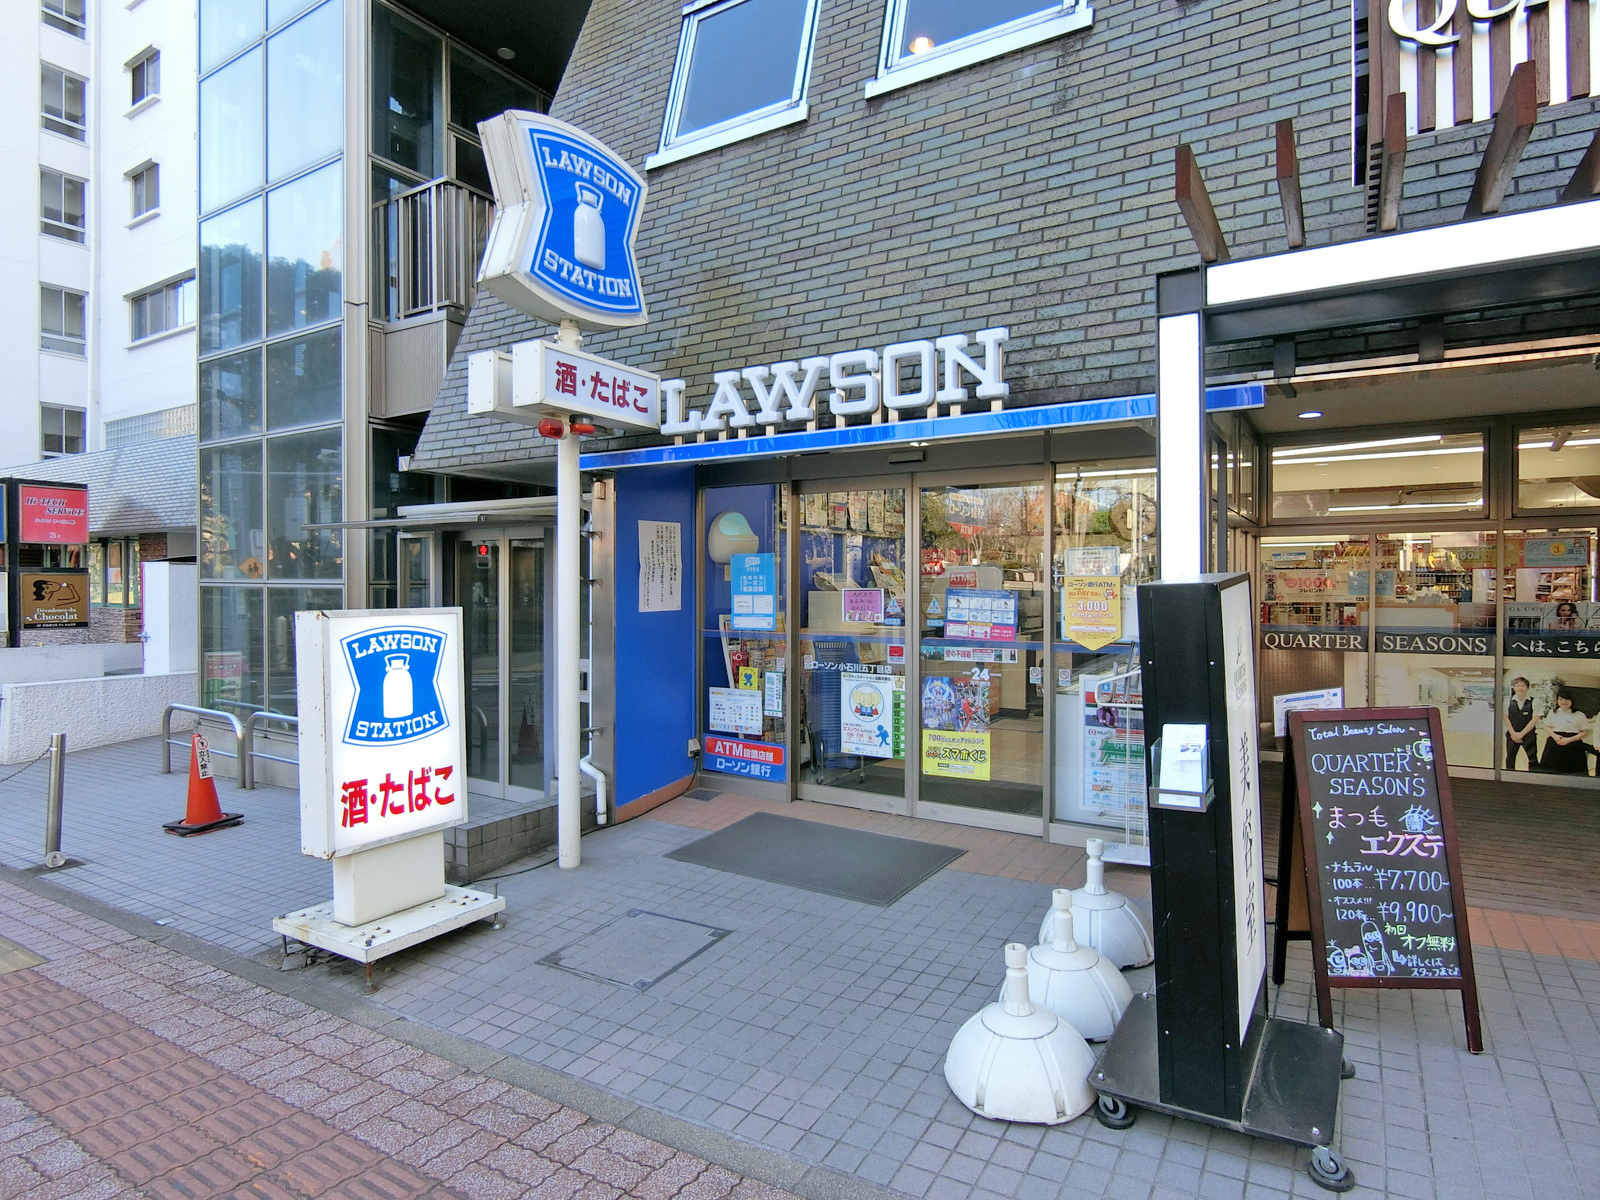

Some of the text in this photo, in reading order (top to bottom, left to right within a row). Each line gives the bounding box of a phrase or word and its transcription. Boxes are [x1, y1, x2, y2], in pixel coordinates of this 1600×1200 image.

[541, 146, 632, 207] LAWSON
[543, 249, 633, 298] STATION
[555, 360, 649, 413] 酒・たばこ
[660, 327, 1010, 436] LAWSON
[34, 612, 78, 621] Chocolat
[352, 633, 438, 659] LAWSON
[1264, 633, 1363, 650] QUARTER
[1382, 635, 1487, 653] SEASONS
[812, 661, 893, 674] ローソン小石川五丁目店
[970, 667, 990, 680] 24
[355, 710, 439, 738] STATION
[1308, 723, 1405, 741] Total Beauty Salon
[199, 750, 209, 777] 立入禁止
[942, 747, 987, 763] スマホくじ
[1311, 752, 1411, 774] QUARTER
[716, 758, 771, 777] ローソン銀行
[341, 765, 455, 828] 酒・たばこ
[1330, 777, 1425, 797] SEASONS
[1328, 805, 1388, 829] まつ毛
[1360, 831, 1444, 858] エクステ
[1384, 923, 1407, 935] 初回
[1400, 934, 1456, 952] オフ無料
[1407, 955, 1443, 967] 詳しくは
